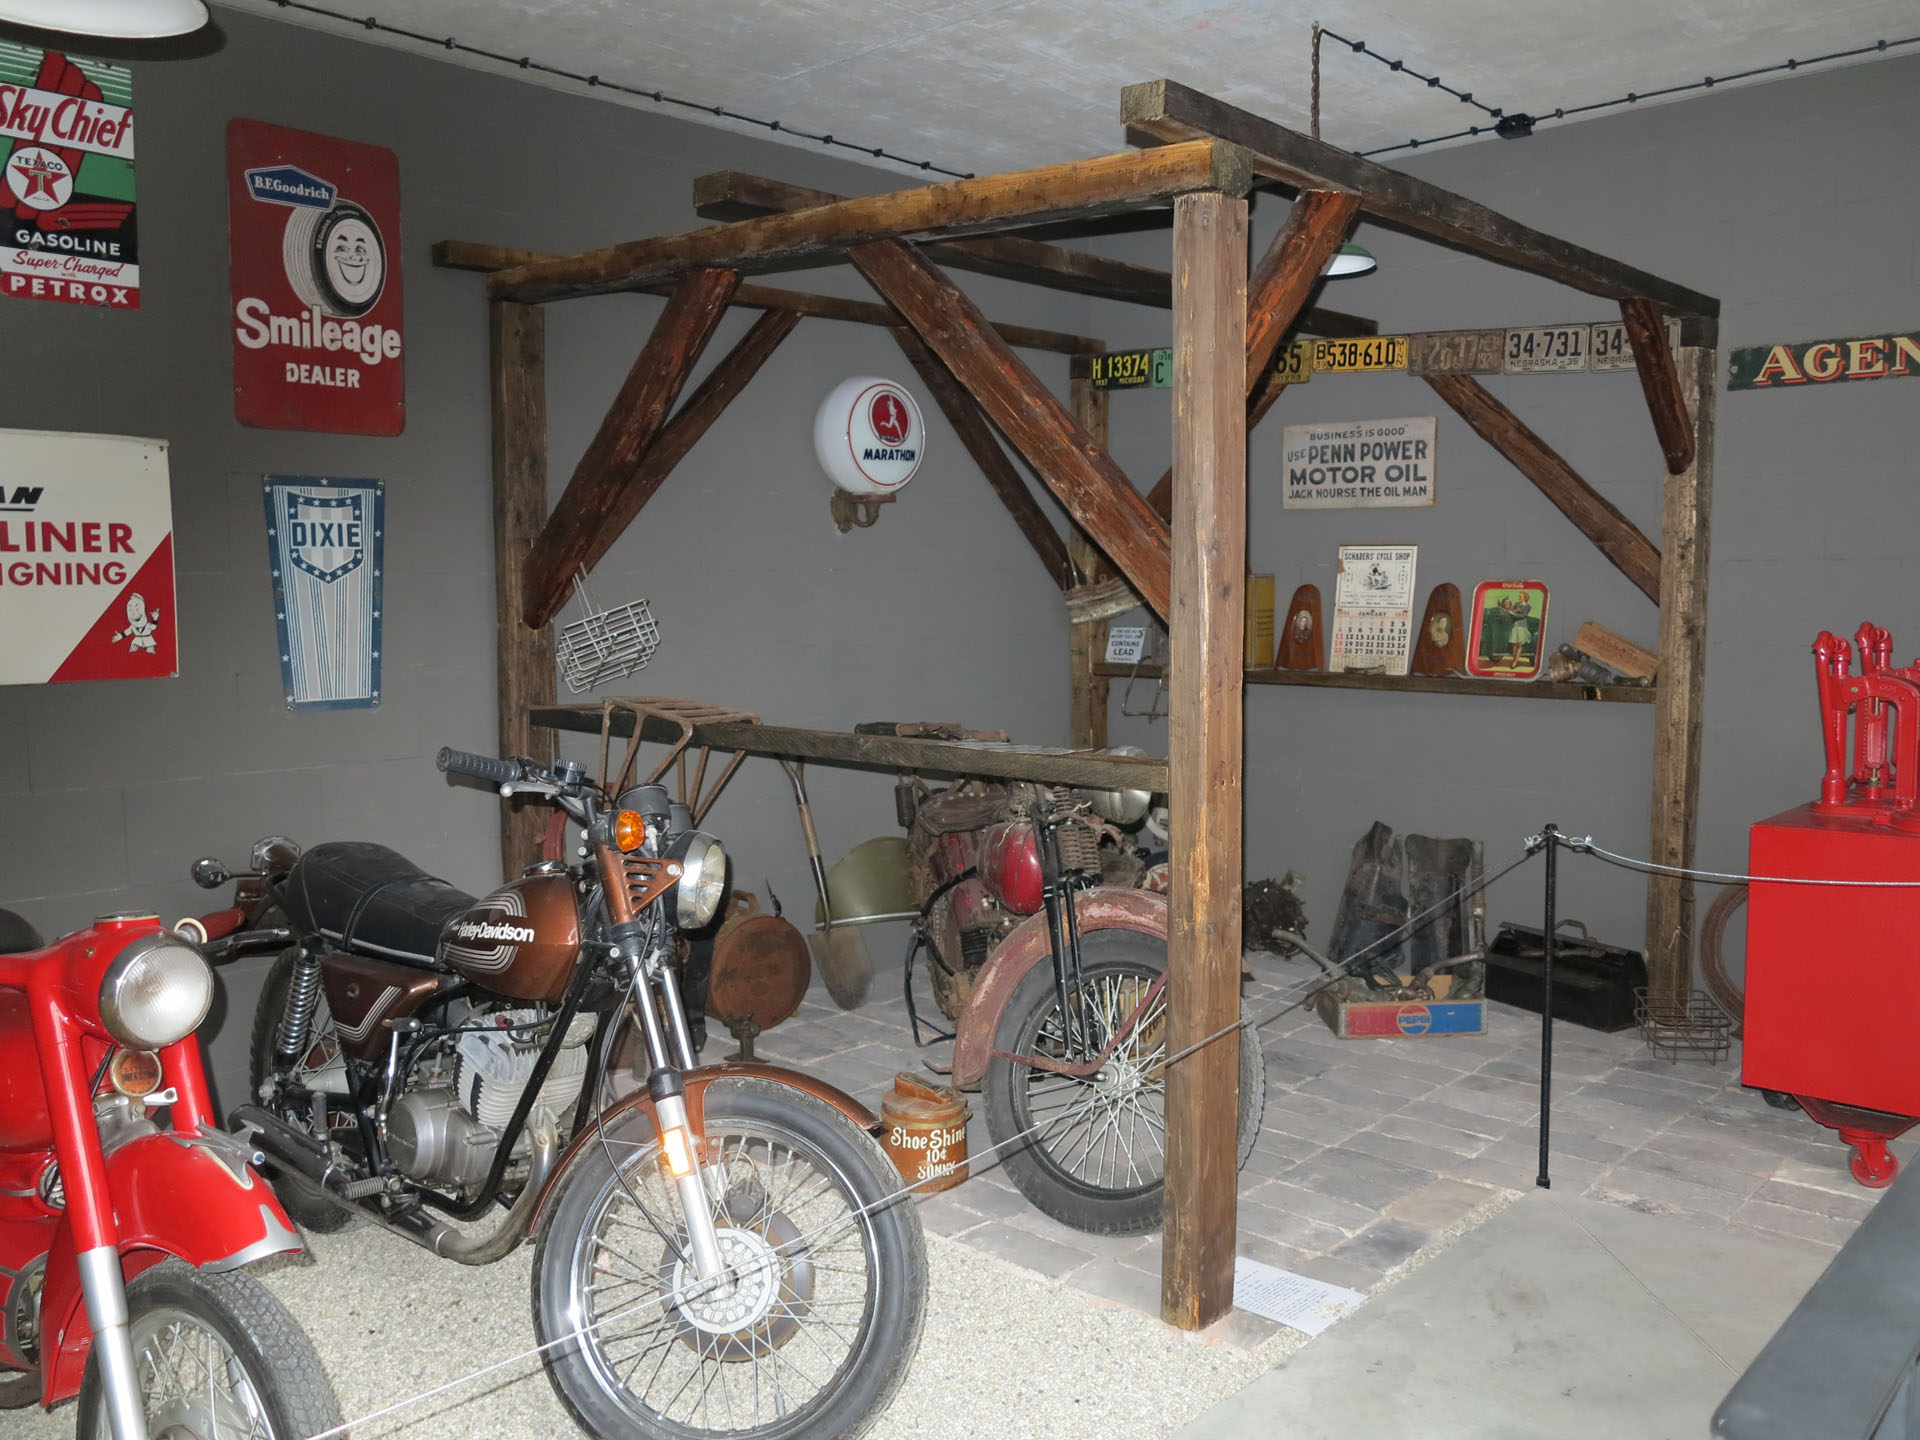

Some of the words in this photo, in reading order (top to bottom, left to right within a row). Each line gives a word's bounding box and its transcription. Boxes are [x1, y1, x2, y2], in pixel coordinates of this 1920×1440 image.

[0, 85, 51, 142] Sky
[52, 97, 133, 149] Chief
[16, 156, 63, 171] TEXACO
[16, 229, 121, 256] GASOLINE
[12, 250, 125, 280] Super-Charged
[10, 275, 128, 304] PETROX
[236, 297, 401, 365] Smileage
[285, 362, 360, 388] DEALER
[1108, 353, 1149, 378] 13374
[1365, 429, 1375, 437] IS
[863, 448, 915, 461] MARATHON
[1287, 448, 1306, 462] USE
[1308, 443, 1356, 464] PENN
[1360, 440, 1428, 462] POWER
[1290, 465, 1376, 486] MOTOR
[1384, 463, 1427, 482] OIL
[1288, 489, 1313, 499] JACK
[1316, 487, 1357, 498] NOURSE
[1360, 487, 1381, 497] THE
[1383, 486, 1400, 497] OIL
[1403, 486, 1427, 497] MAN
[291, 522, 361, 547] DIXIE
[1113, 648, 1134, 656] LEAD
[457, 920, 536, 942] Harley-Davidson
[890, 1127, 928, 1149] Shoe
[929, 1127, 966, 1149] Shine
